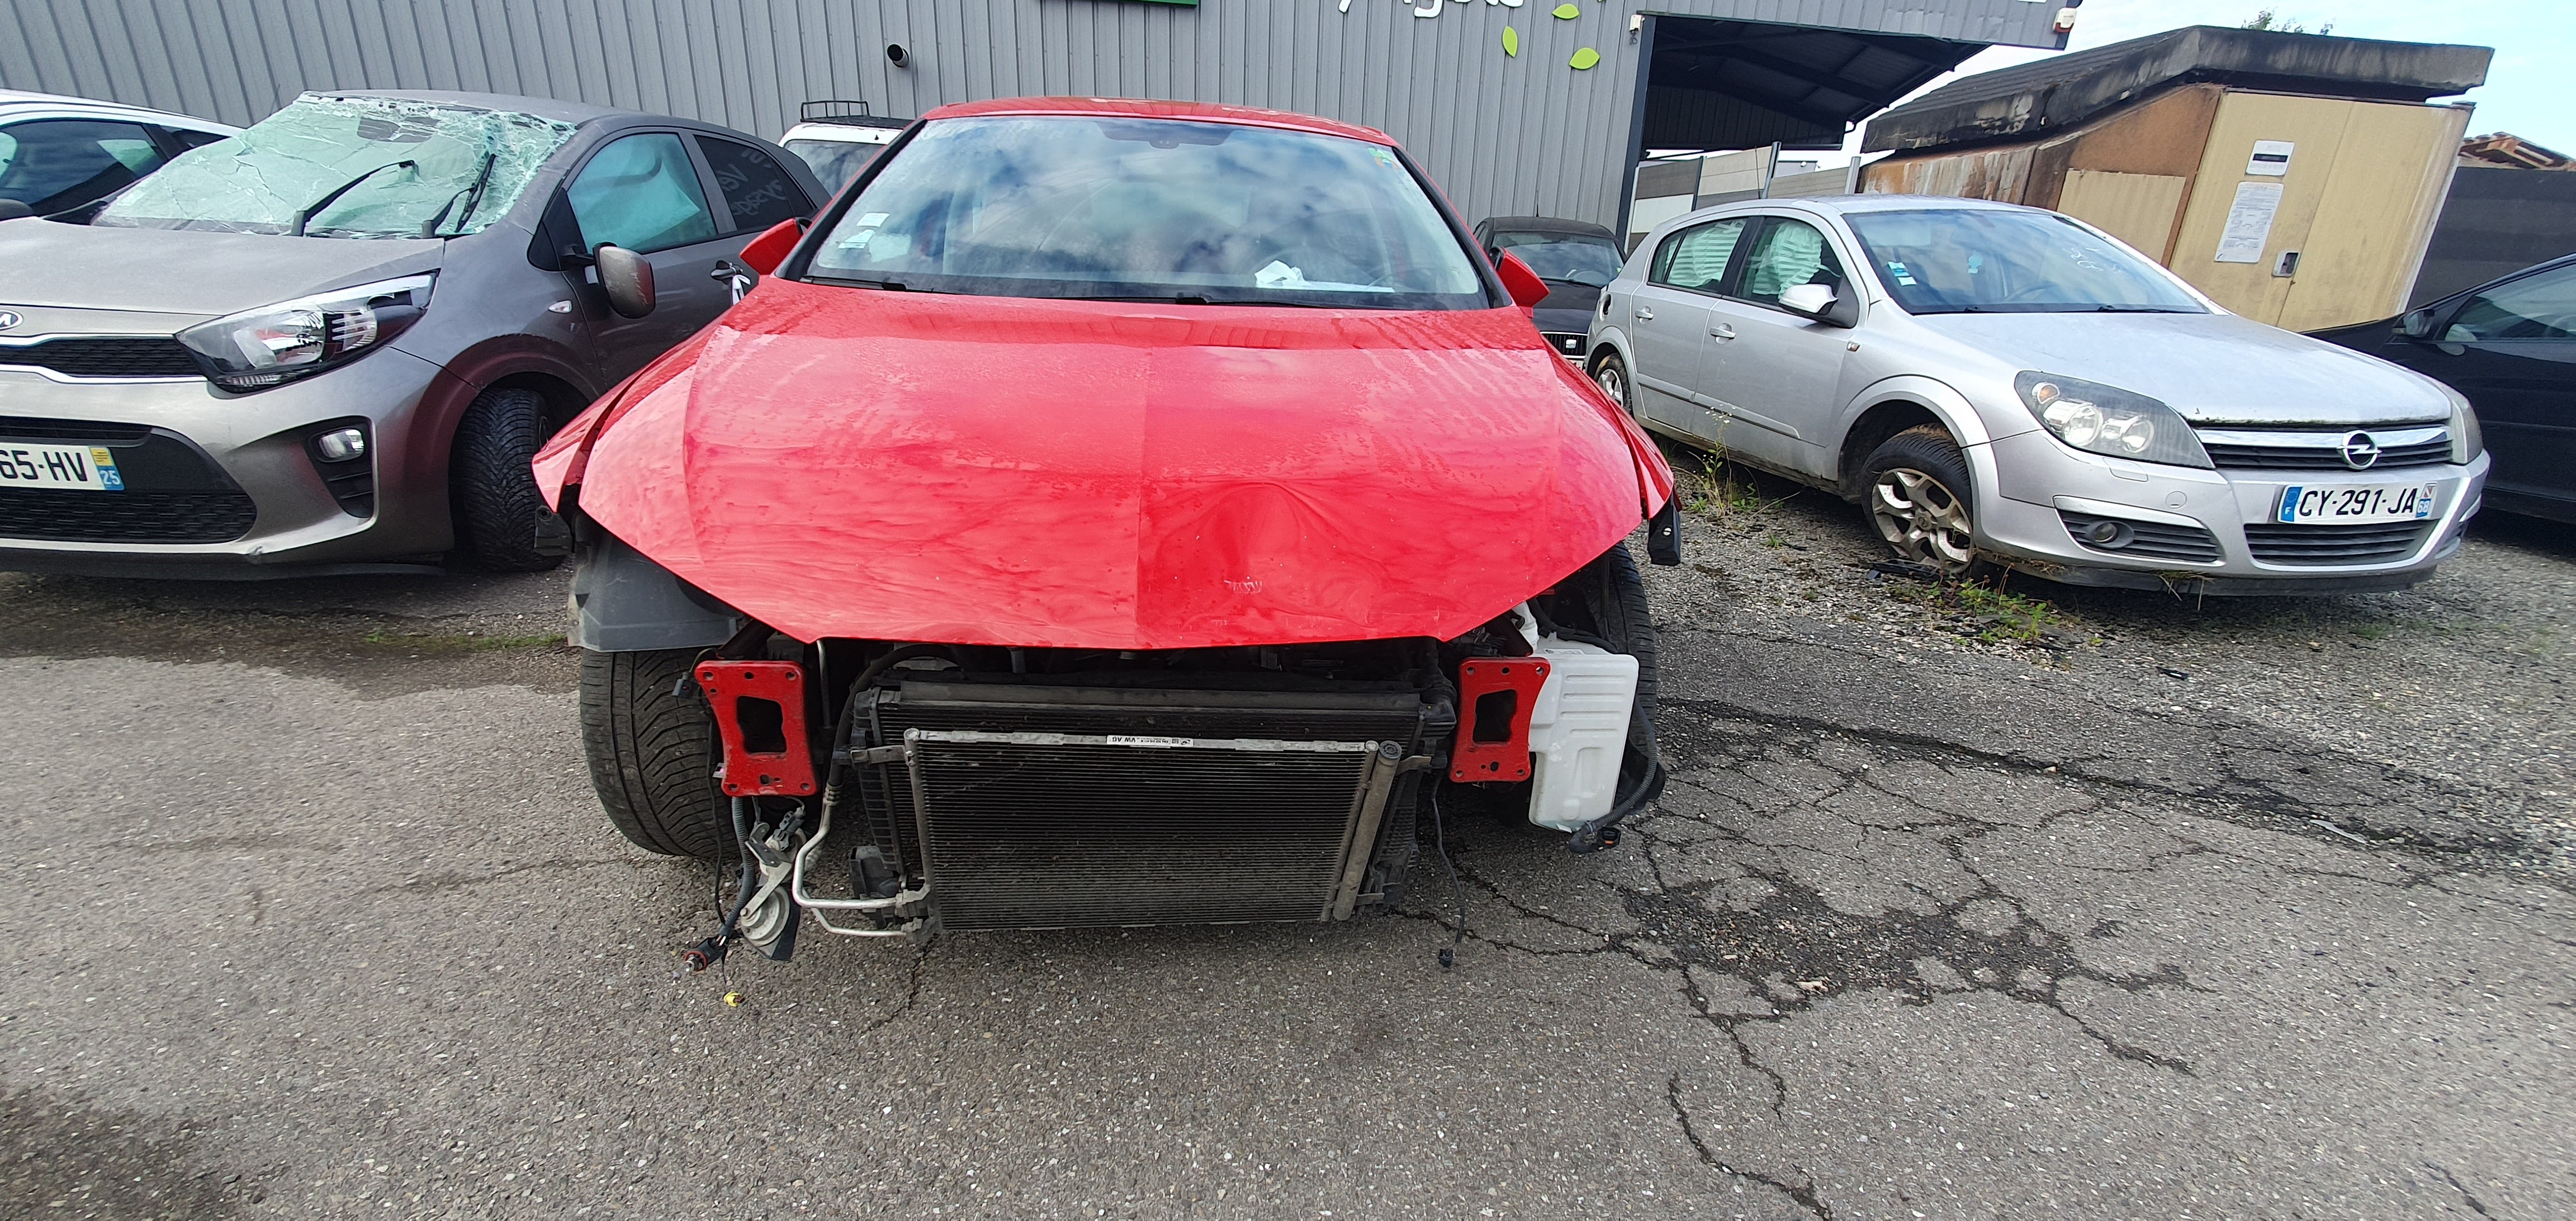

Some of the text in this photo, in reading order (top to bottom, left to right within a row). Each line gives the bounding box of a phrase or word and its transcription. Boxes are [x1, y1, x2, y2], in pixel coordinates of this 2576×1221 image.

[100, 470, 121, 485] 25
[2298, 488, 2418, 517] CY-291-JA
[2417, 500, 2429, 514] 68
[2284, 507, 2291, 515] F
